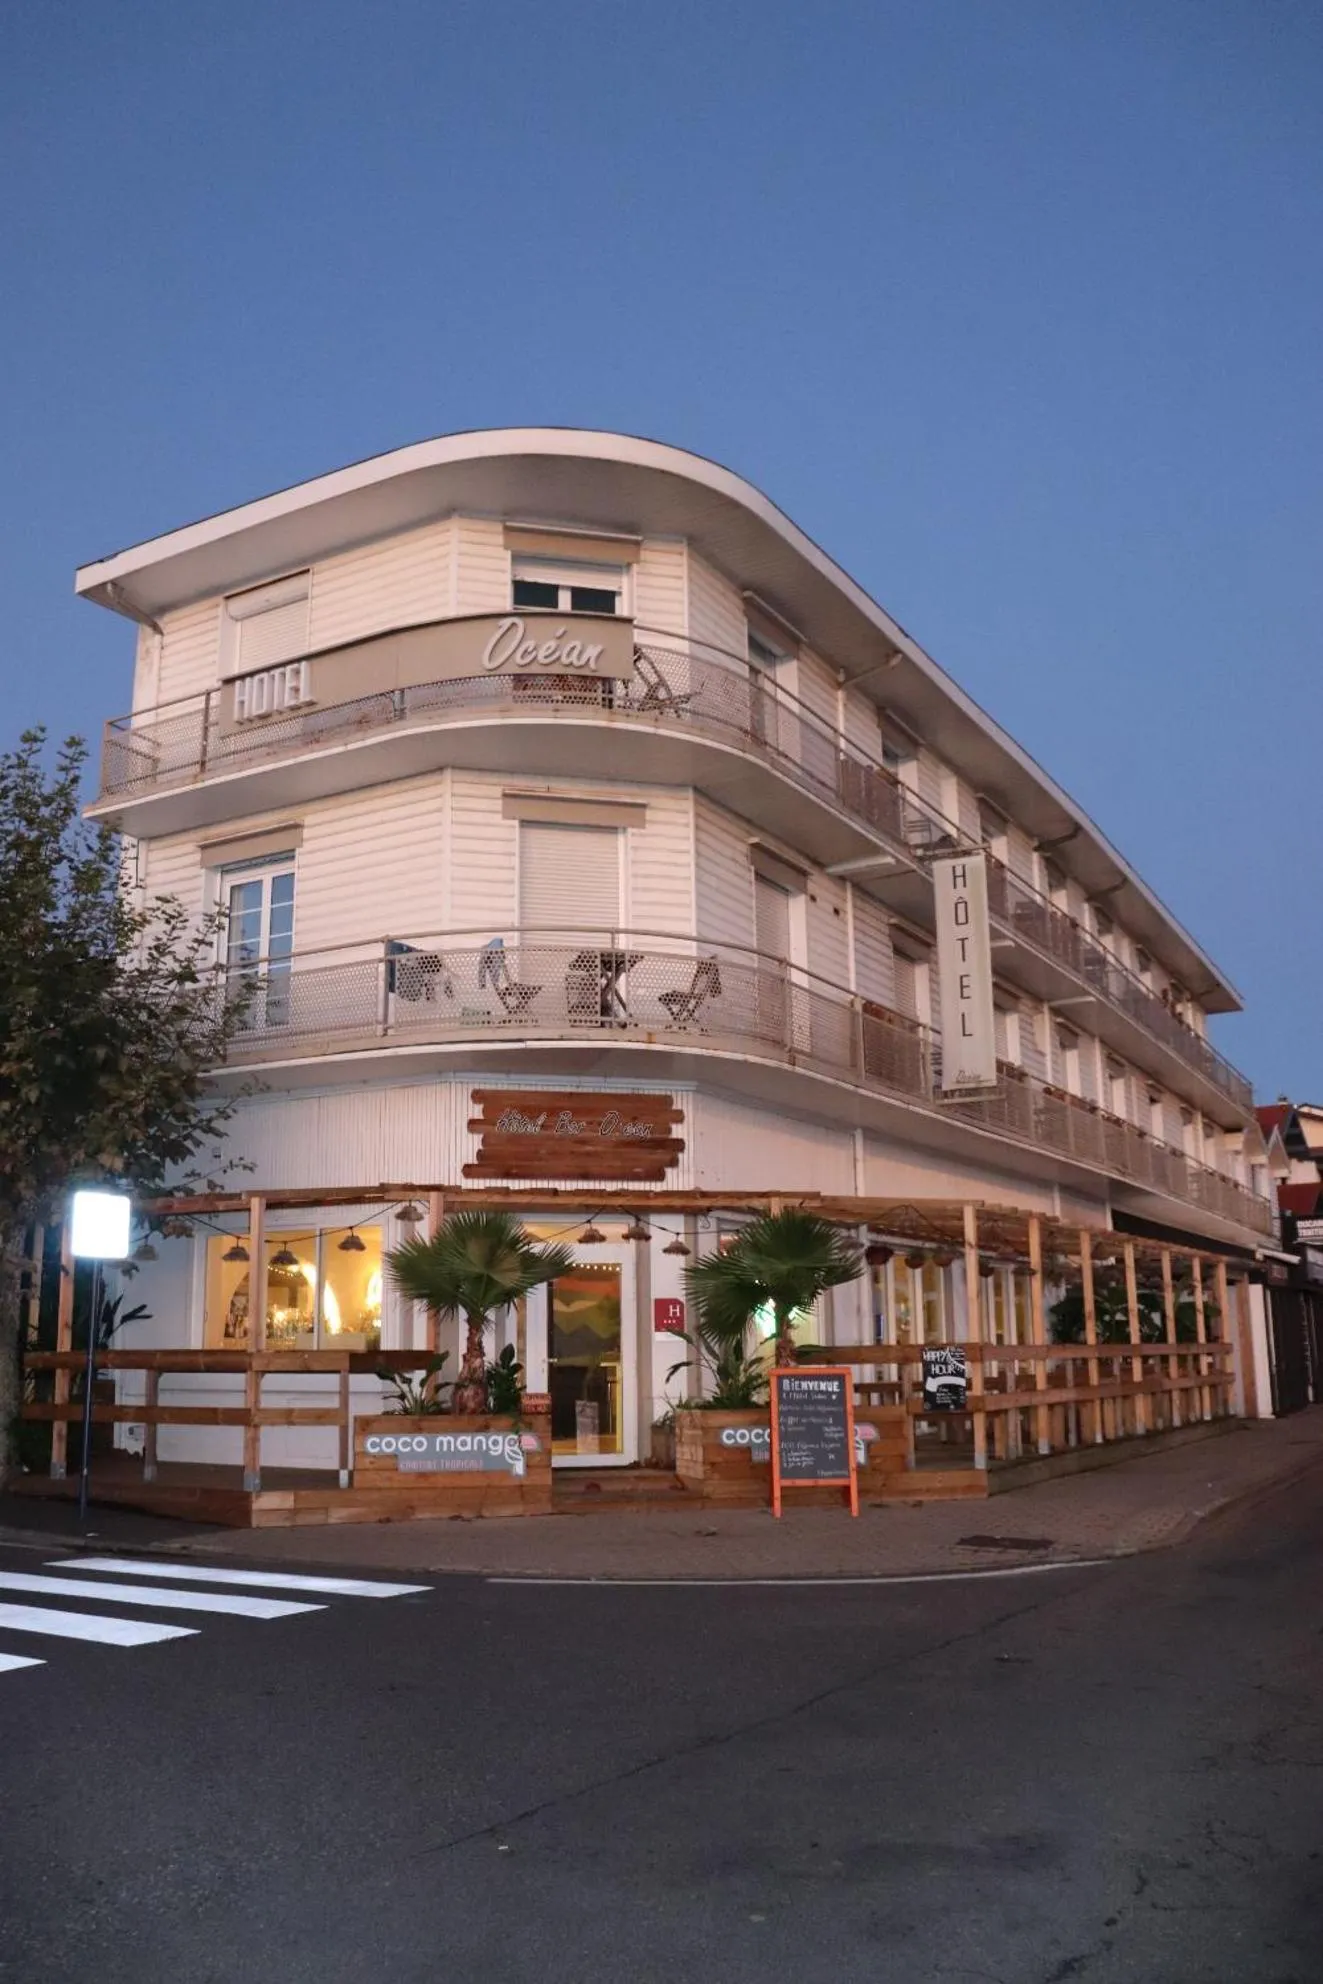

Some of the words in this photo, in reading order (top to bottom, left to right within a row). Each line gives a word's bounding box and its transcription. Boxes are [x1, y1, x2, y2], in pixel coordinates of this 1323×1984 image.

[233, 661, 317, 725] HOTEL
[481, 617, 606, 671] Océan
[669, 1304, 680, 1317] H
[931, 1363, 956, 1375] HOUR
[366, 1436, 428, 1453] coco
